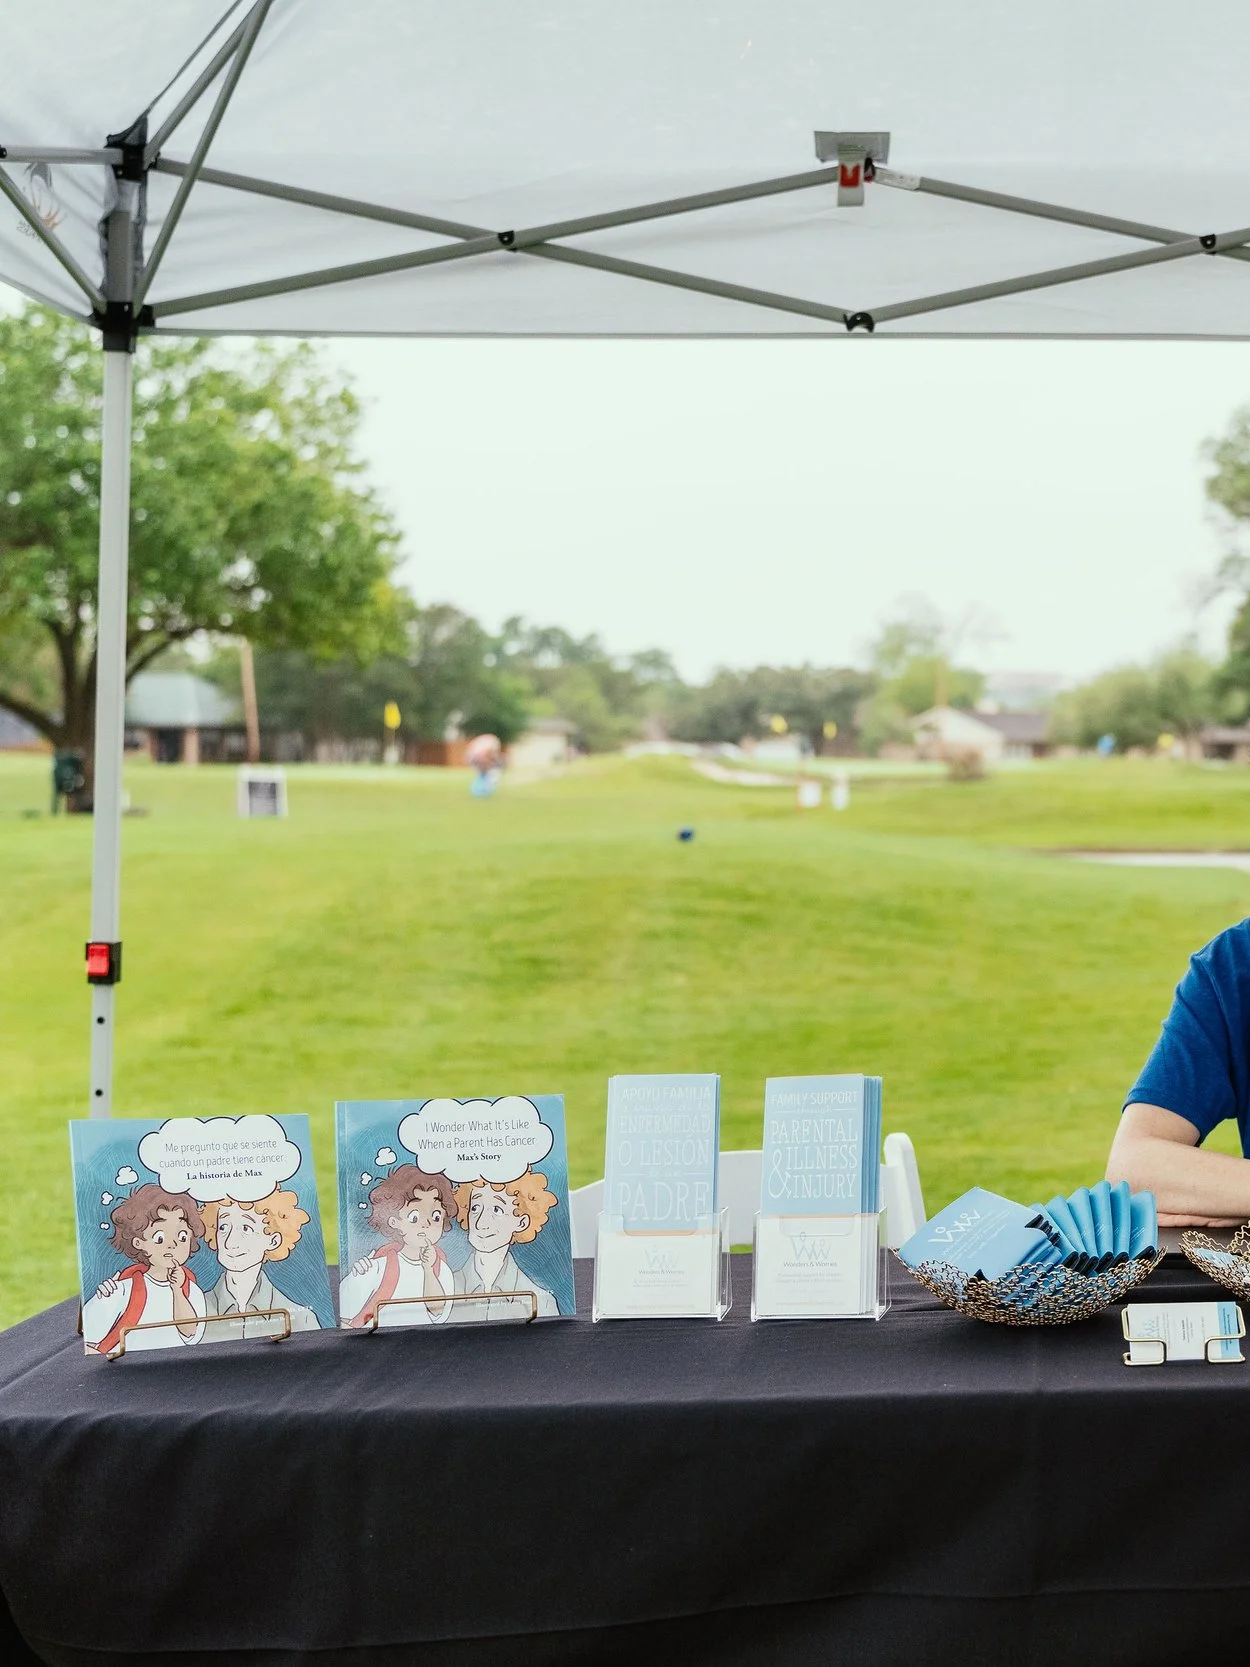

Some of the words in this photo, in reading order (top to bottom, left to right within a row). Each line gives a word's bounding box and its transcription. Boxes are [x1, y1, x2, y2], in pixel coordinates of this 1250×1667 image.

[621, 1086, 660, 1101] APOYO
[771, 1092, 808, 1107] FAMILY
[810, 1090, 858, 1105] SUPPORT
[430, 1122, 466, 1133] Wonder
[468, 1120, 493, 1131] What
[495, 1119, 510, 1131] It's
[511, 1119, 530, 1130] Like
[619, 1114, 711, 1134] ENFERMEDAD
[770, 1118, 858, 1144] PARENTAL
[165, 1142, 179, 1153] Me
[180, 1142, 221, 1155] pregunto
[240, 1141, 250, 1150] se
[252, 1139, 277, 1150] siente
[418, 1138, 445, 1150] When
[454, 1137, 484, 1148] Parent
[486, 1136, 504, 1147] Has
[505, 1135, 536, 1147] Cancer
[618, 1139, 633, 1167] O
[639, 1134, 710, 1166] LESIÓN
[159, 1158, 192, 1169] cuando
[193, 1158, 205, 1167] un
[206, 1156, 231, 1169] padre
[232, 1155, 255, 1165] tiene
[456, 1153, 479, 1162] Max's
[480, 1153, 502, 1162] Story
[786, 1144, 858, 1170] ILLNESS
[186, 1172, 198, 1180] La
[199, 1170, 232, 1180] historia
[232, 1169, 243, 1178] de
[244, 1169, 263, 1178] Max
[790, 1173, 858, 1199] INJURY
[617, 1181, 710, 1222] PADRE
